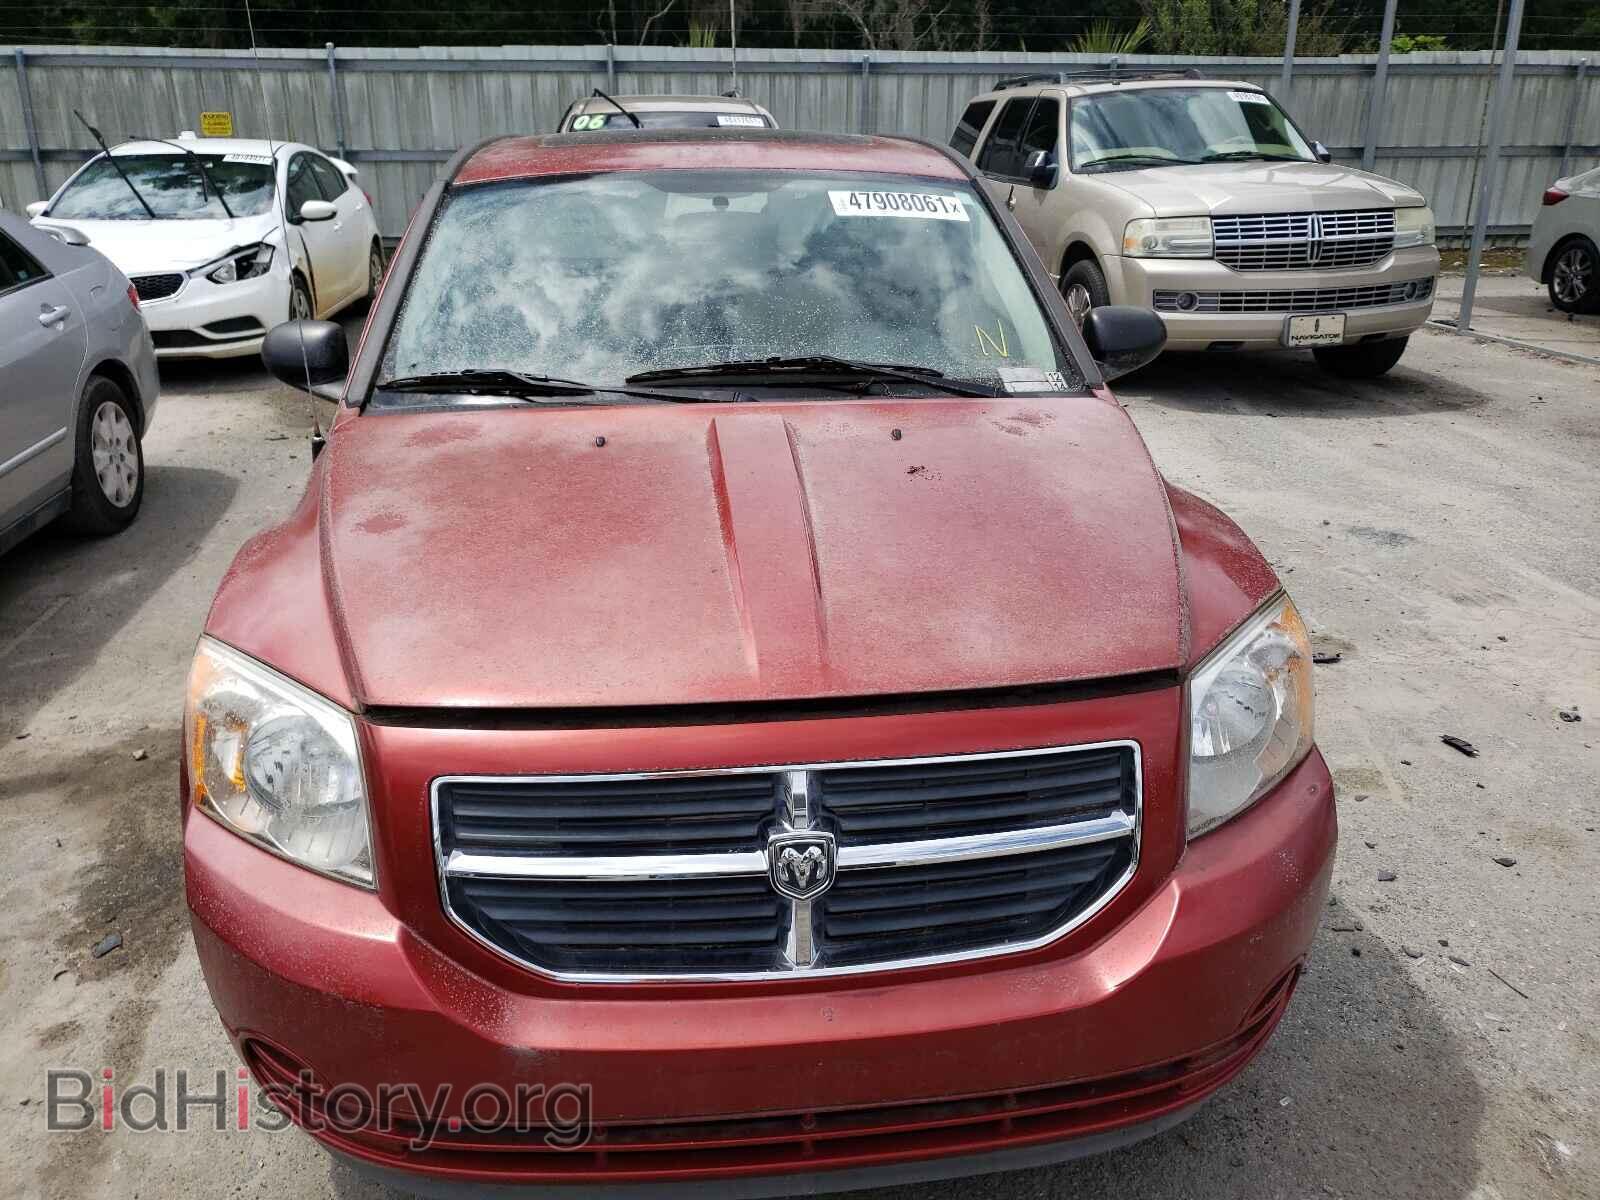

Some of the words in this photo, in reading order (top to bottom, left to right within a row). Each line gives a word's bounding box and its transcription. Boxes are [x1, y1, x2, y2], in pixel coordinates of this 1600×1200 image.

[573, 114, 606, 130] 06
[849, 192, 949, 213] 47908061
[974, 319, 1008, 358] N
[1291, 333, 1341, 341] NAVIGATOR
[1048, 372, 1063, 381] 12
